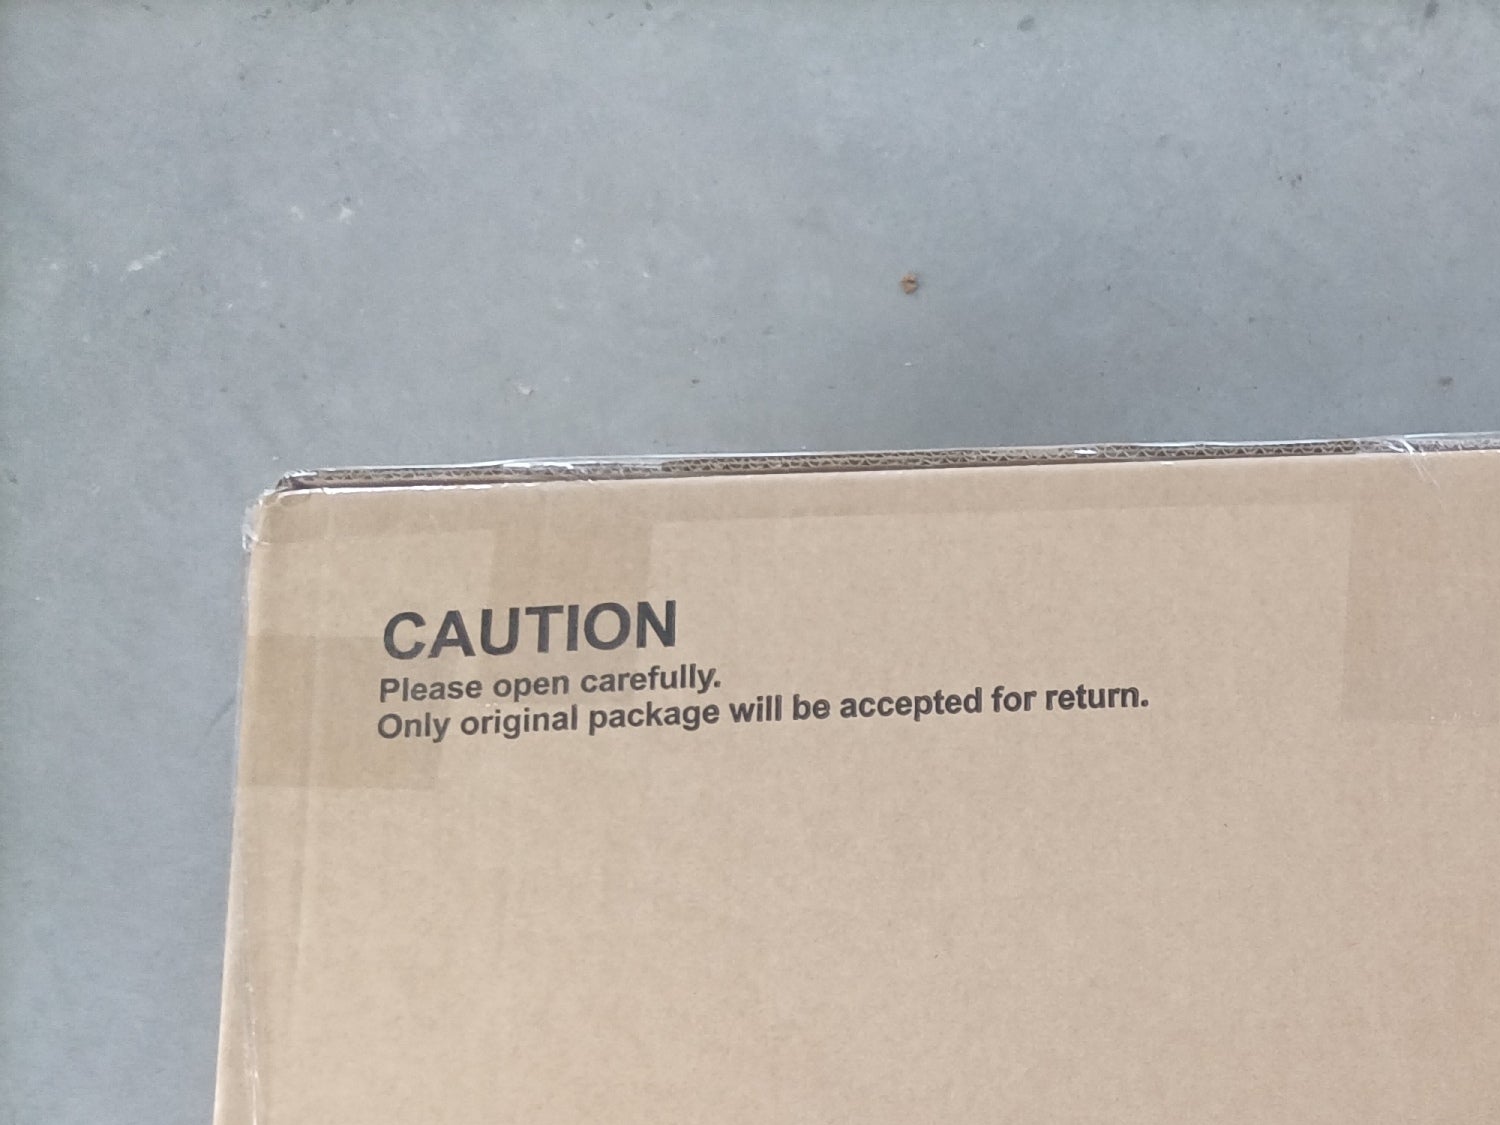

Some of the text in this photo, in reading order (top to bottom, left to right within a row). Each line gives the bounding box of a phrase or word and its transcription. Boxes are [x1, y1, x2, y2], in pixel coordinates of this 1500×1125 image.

[383, 599, 677, 661] CAUTION
[377, 683, 1149, 744] Only original package will be accepted for return.
[379, 663, 721, 704] Please open carefully.
